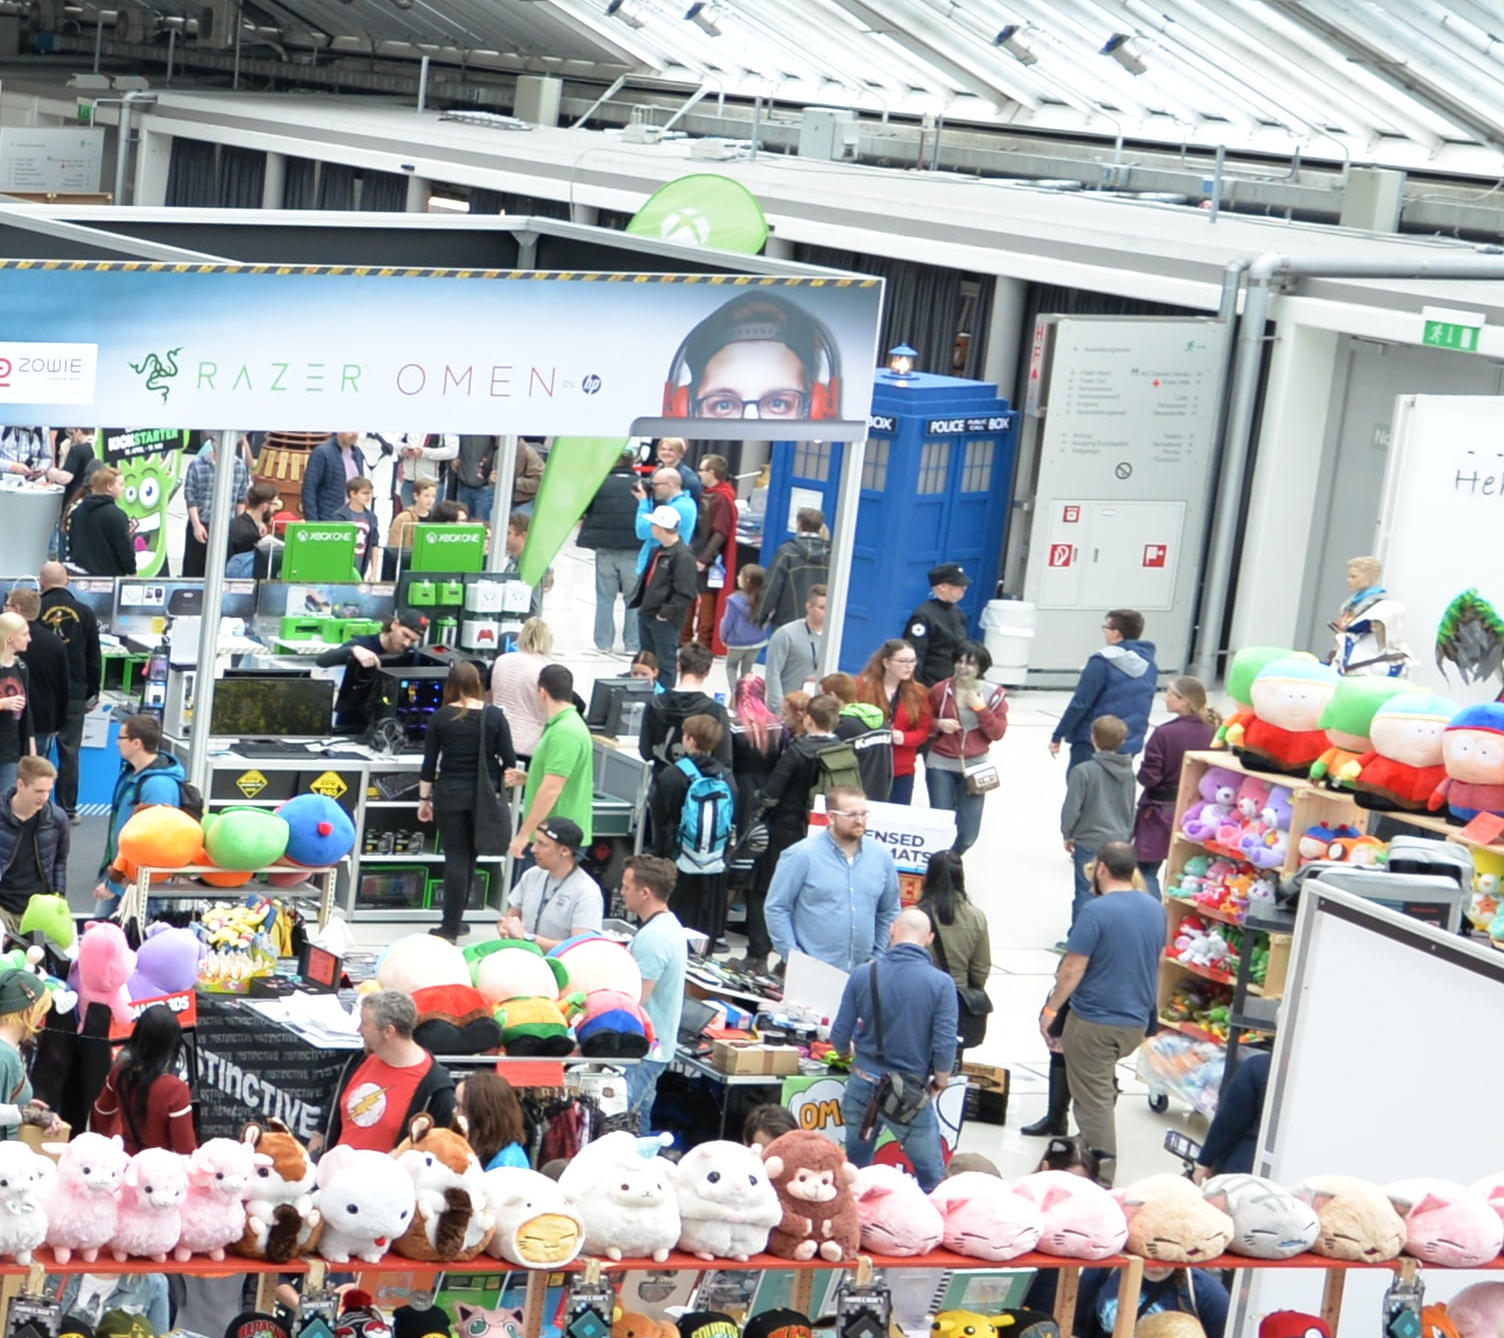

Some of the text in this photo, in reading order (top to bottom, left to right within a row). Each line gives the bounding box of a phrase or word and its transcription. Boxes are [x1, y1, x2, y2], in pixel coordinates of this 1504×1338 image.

[18, 357, 82, 374] ZOWIE
[396, 363, 557, 398] OMEN
[930, 417, 1010, 434] POLICE BOX
[107, 428, 179, 452] KICKSTARTER
[309, 531, 351, 542] XBOX ONE
[438, 532, 480, 543] XBOX ONE
[798, 1099, 845, 1130] OM
